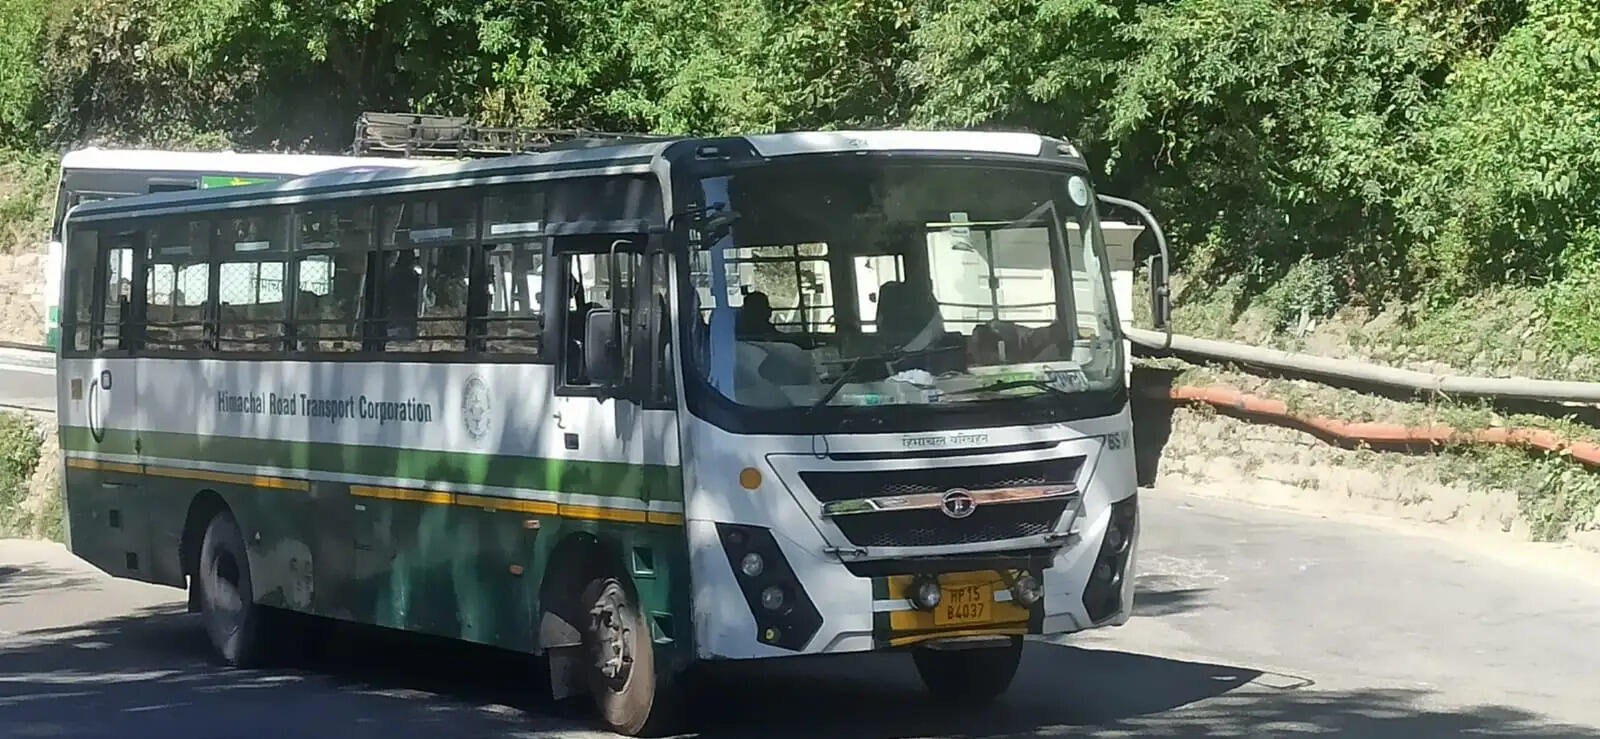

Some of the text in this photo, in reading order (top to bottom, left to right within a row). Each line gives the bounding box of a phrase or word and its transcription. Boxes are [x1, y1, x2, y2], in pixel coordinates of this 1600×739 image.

[217, 390, 433, 424] Himachal Road Transport Corporation
[902, 434, 946, 449] हिमाचल
[1108, 432, 1121, 450] BS
[947, 602, 984, 620] B4037
